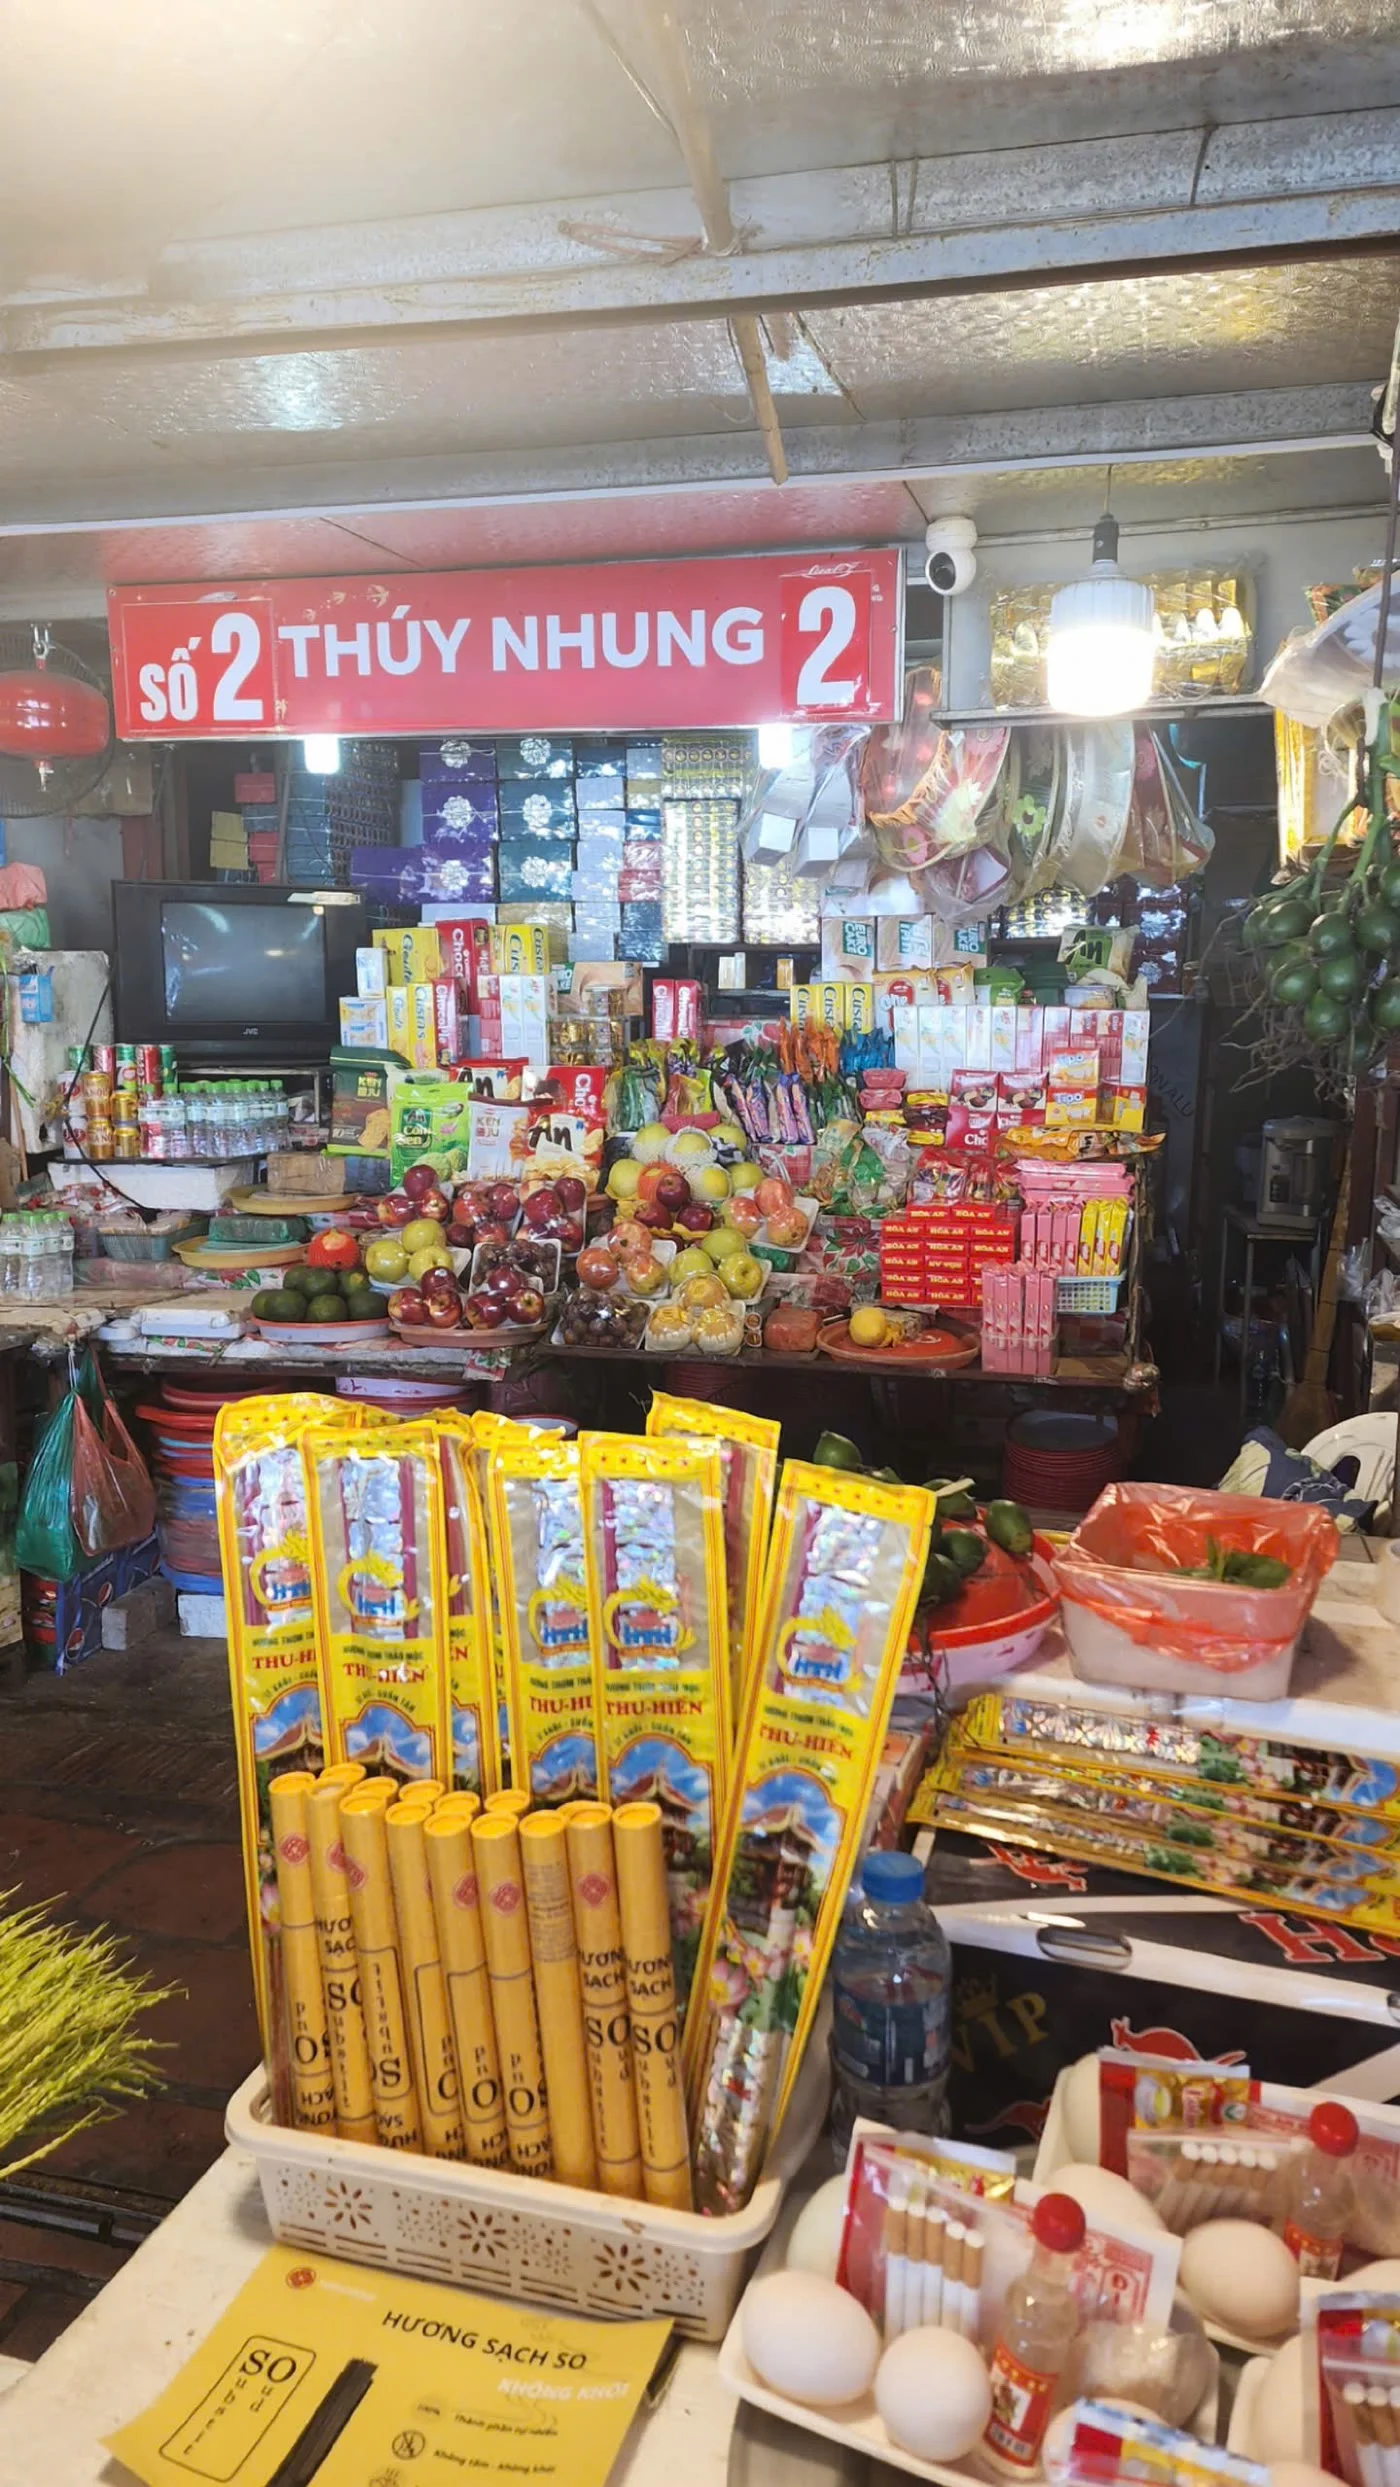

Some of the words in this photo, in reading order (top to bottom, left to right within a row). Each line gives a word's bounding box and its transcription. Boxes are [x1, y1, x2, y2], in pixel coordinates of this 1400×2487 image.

[278, 605, 472, 677] THÚY
[491, 608, 764, 673] NHUNG
[796, 586, 855, 706] 2
[139, 637, 203, 722] SỐ
[211, 612, 263, 721] 2
[856, 923, 868, 956] EURO
[967, 925, 979, 953] URO
[458, 1066, 494, 1099] An
[528, 1114, 573, 1151] An
[907, 1290, 919, 1298] AN
[586, 2015, 630, 2048] SO
[632, 2020, 677, 2056] SO
[950, 1991, 1050, 2073] VIP
[382, 2310, 479, 2350] HƯƠNG
[482, 2337, 549, 2367] SẠCH
[553, 2352, 588, 2370] SO
[239, 2349, 297, 2384] SO
[498, 2378, 572, 2401] KHÔNG
